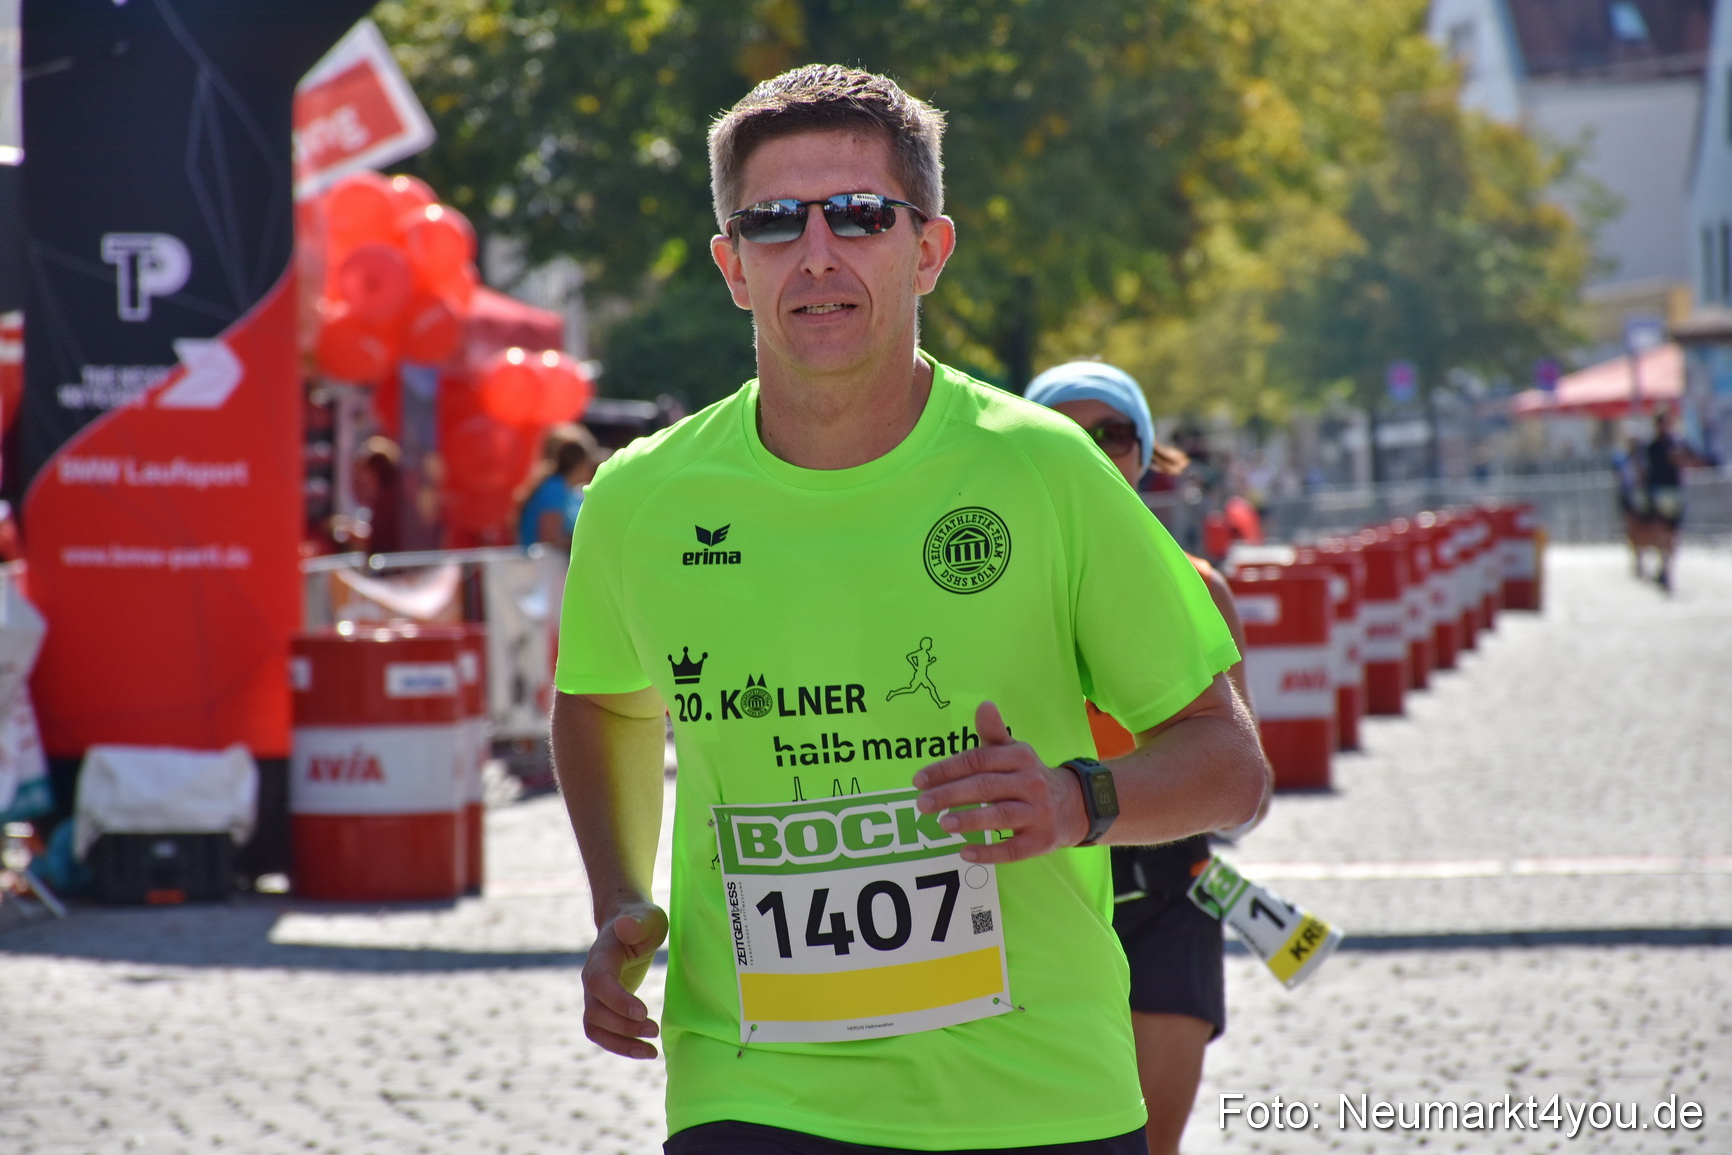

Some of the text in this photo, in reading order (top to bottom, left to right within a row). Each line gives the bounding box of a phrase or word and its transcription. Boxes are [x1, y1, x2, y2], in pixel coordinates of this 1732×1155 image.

[931, 514, 1004, 567] LEICHTATHLETIK-TEAM
[683, 548, 741, 565] erima
[940, 563, 997, 587] DSHS KÖLN
[674, 692, 713, 722] 20.
[755, 869, 961, 959] 1407
